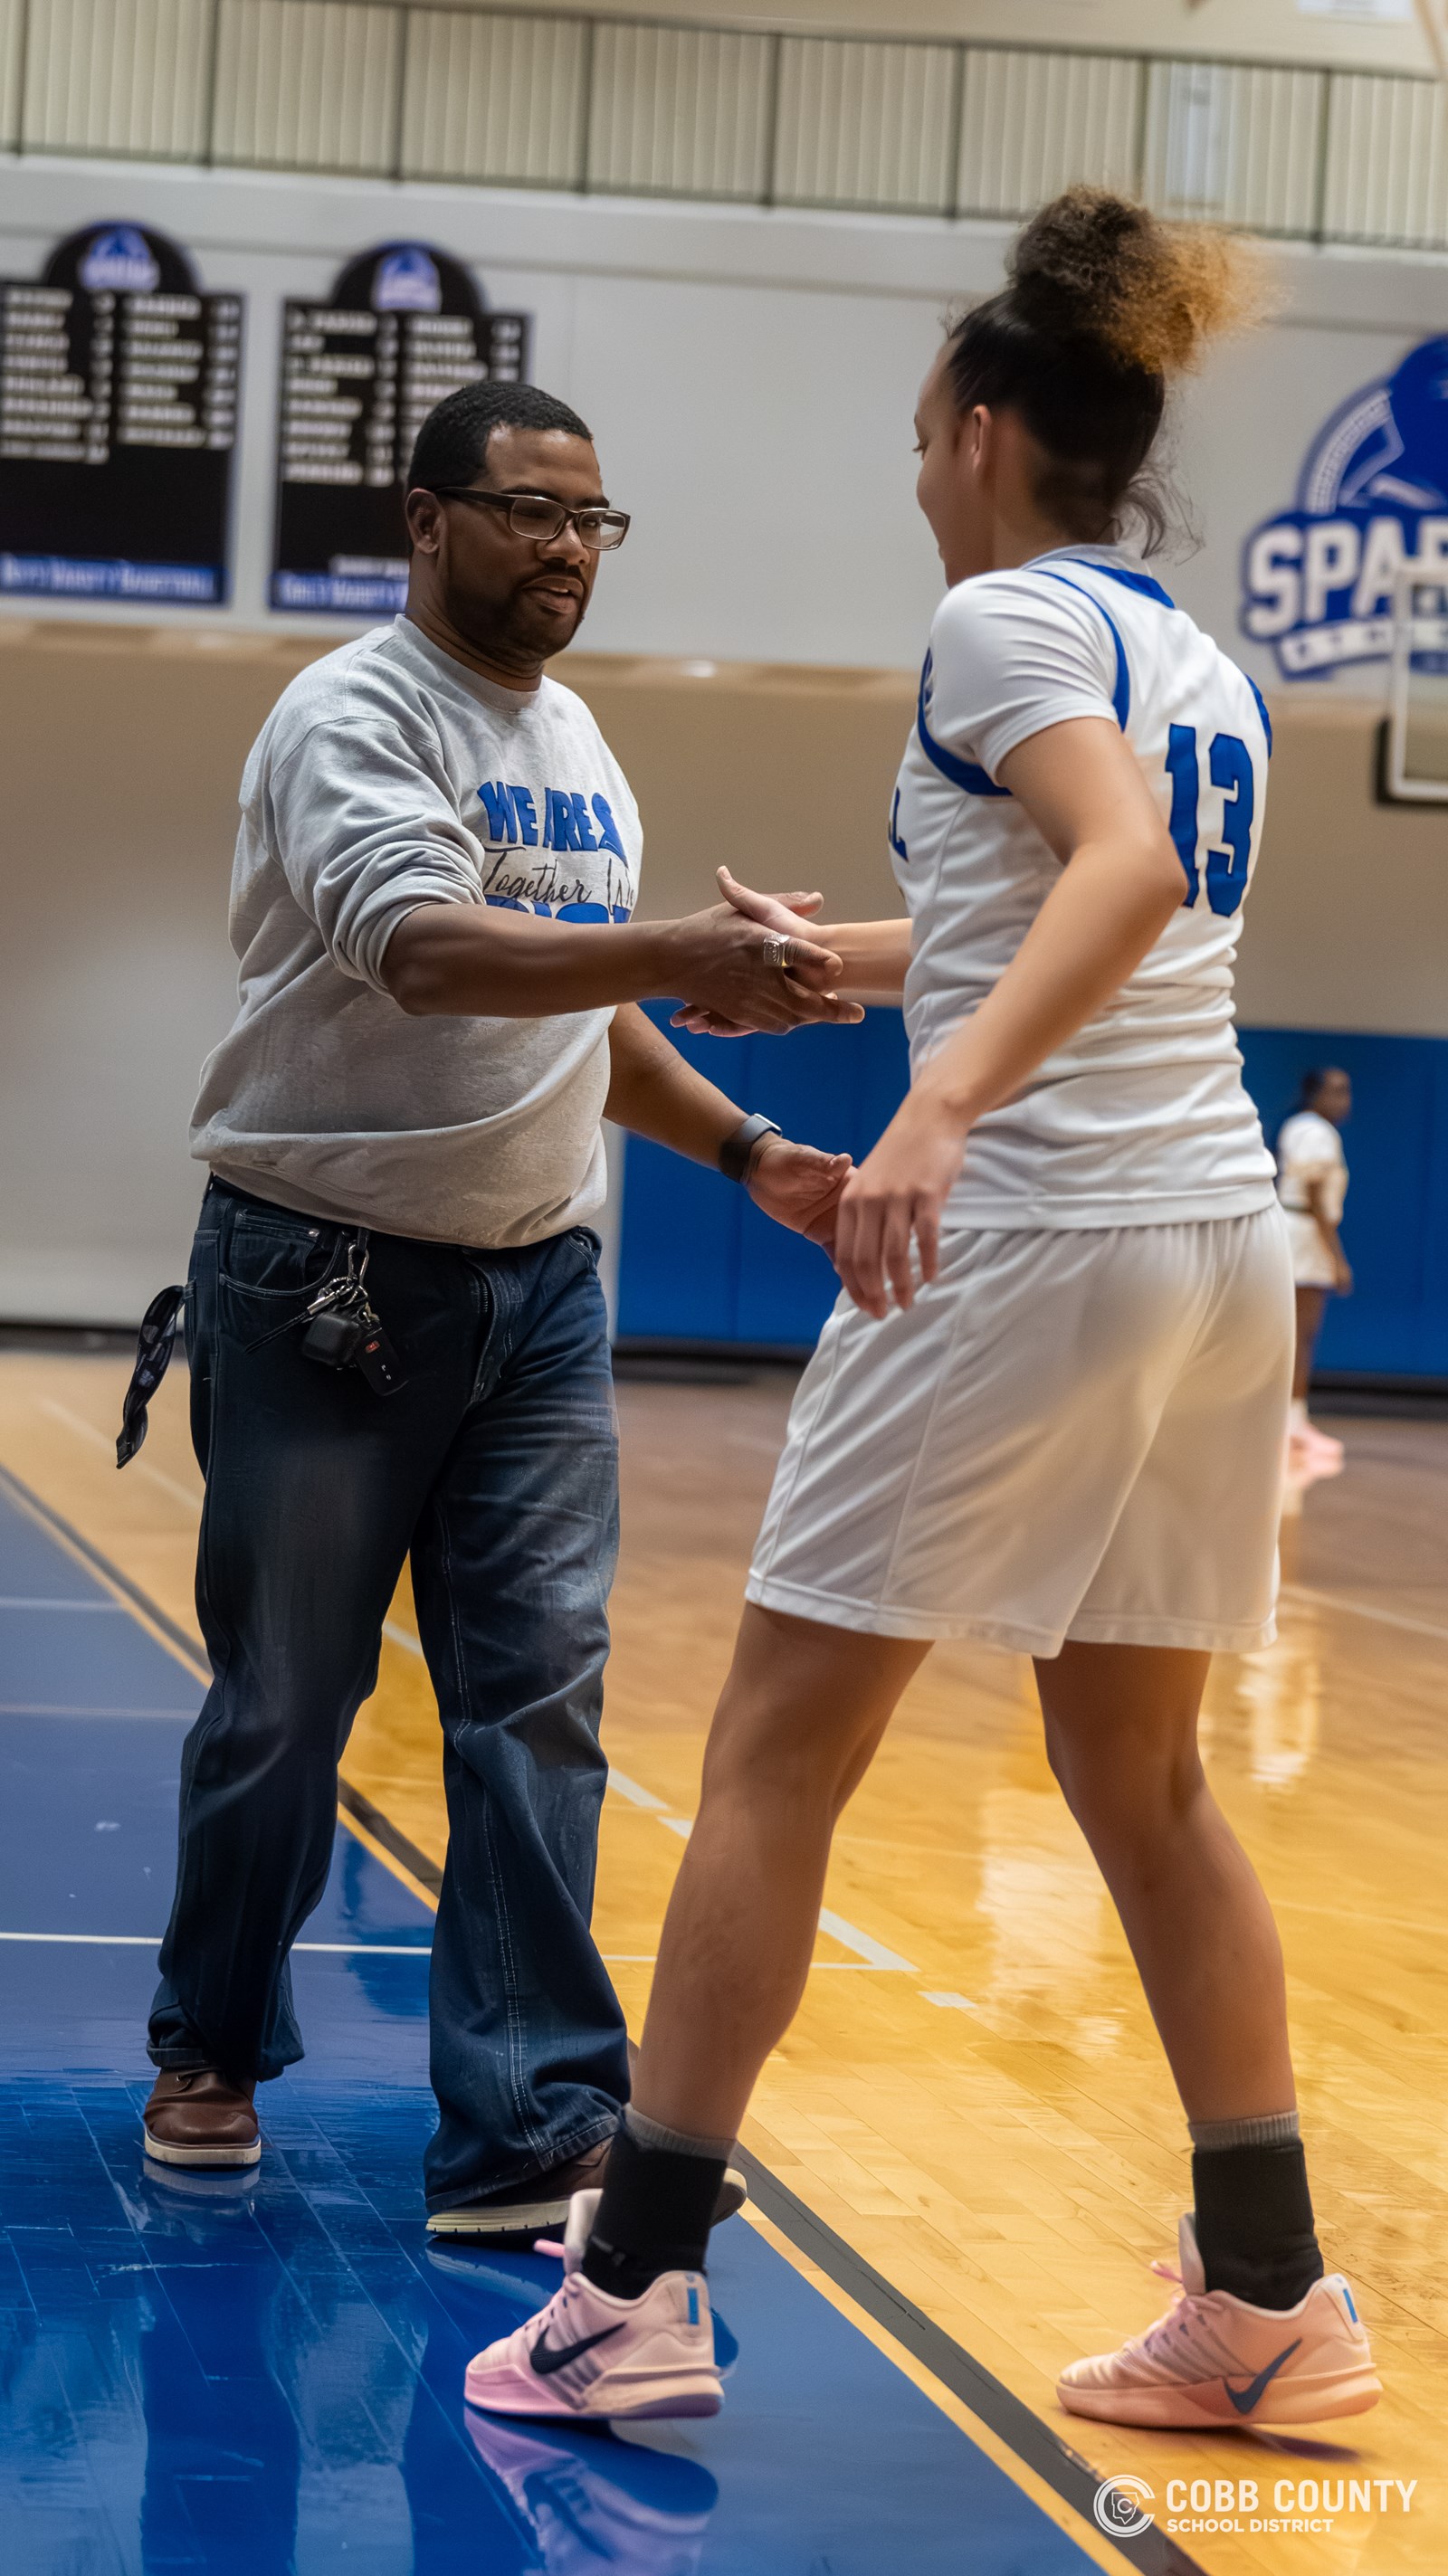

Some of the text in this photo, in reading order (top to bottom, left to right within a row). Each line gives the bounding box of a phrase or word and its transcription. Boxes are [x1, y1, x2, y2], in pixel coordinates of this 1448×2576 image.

[477, 781, 538, 846] WE
[543, 787, 598, 851] ARE
[1166, 723, 1254, 917] 13
[482, 846, 593, 903] Together
